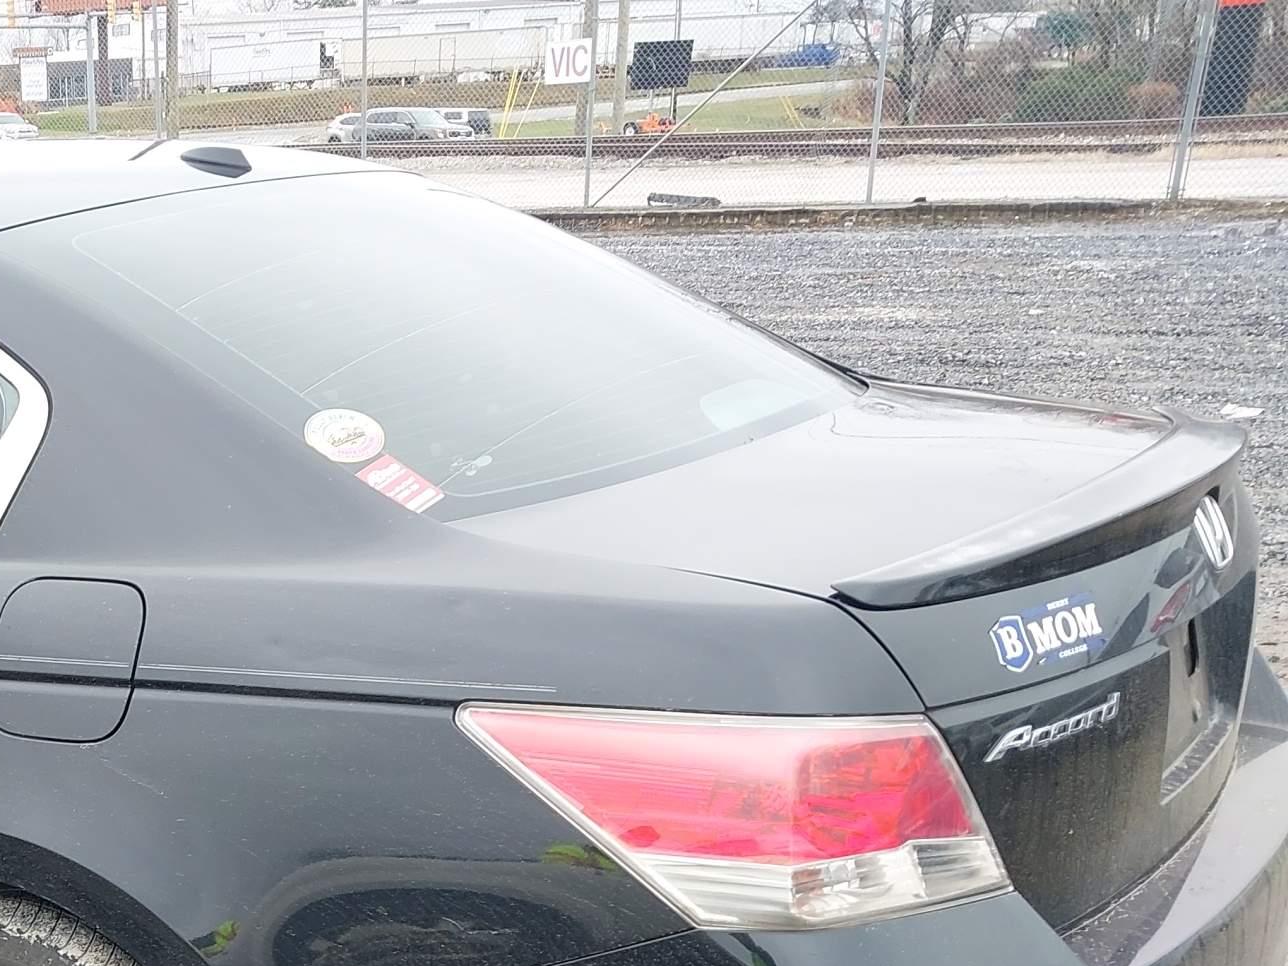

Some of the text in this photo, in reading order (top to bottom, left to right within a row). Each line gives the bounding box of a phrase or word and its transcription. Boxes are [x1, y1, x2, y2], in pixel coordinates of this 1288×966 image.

[551, 45, 589, 78] VIC
[997, 603, 1103, 660] B MOM
[982, 692, 1121, 763] Accord
